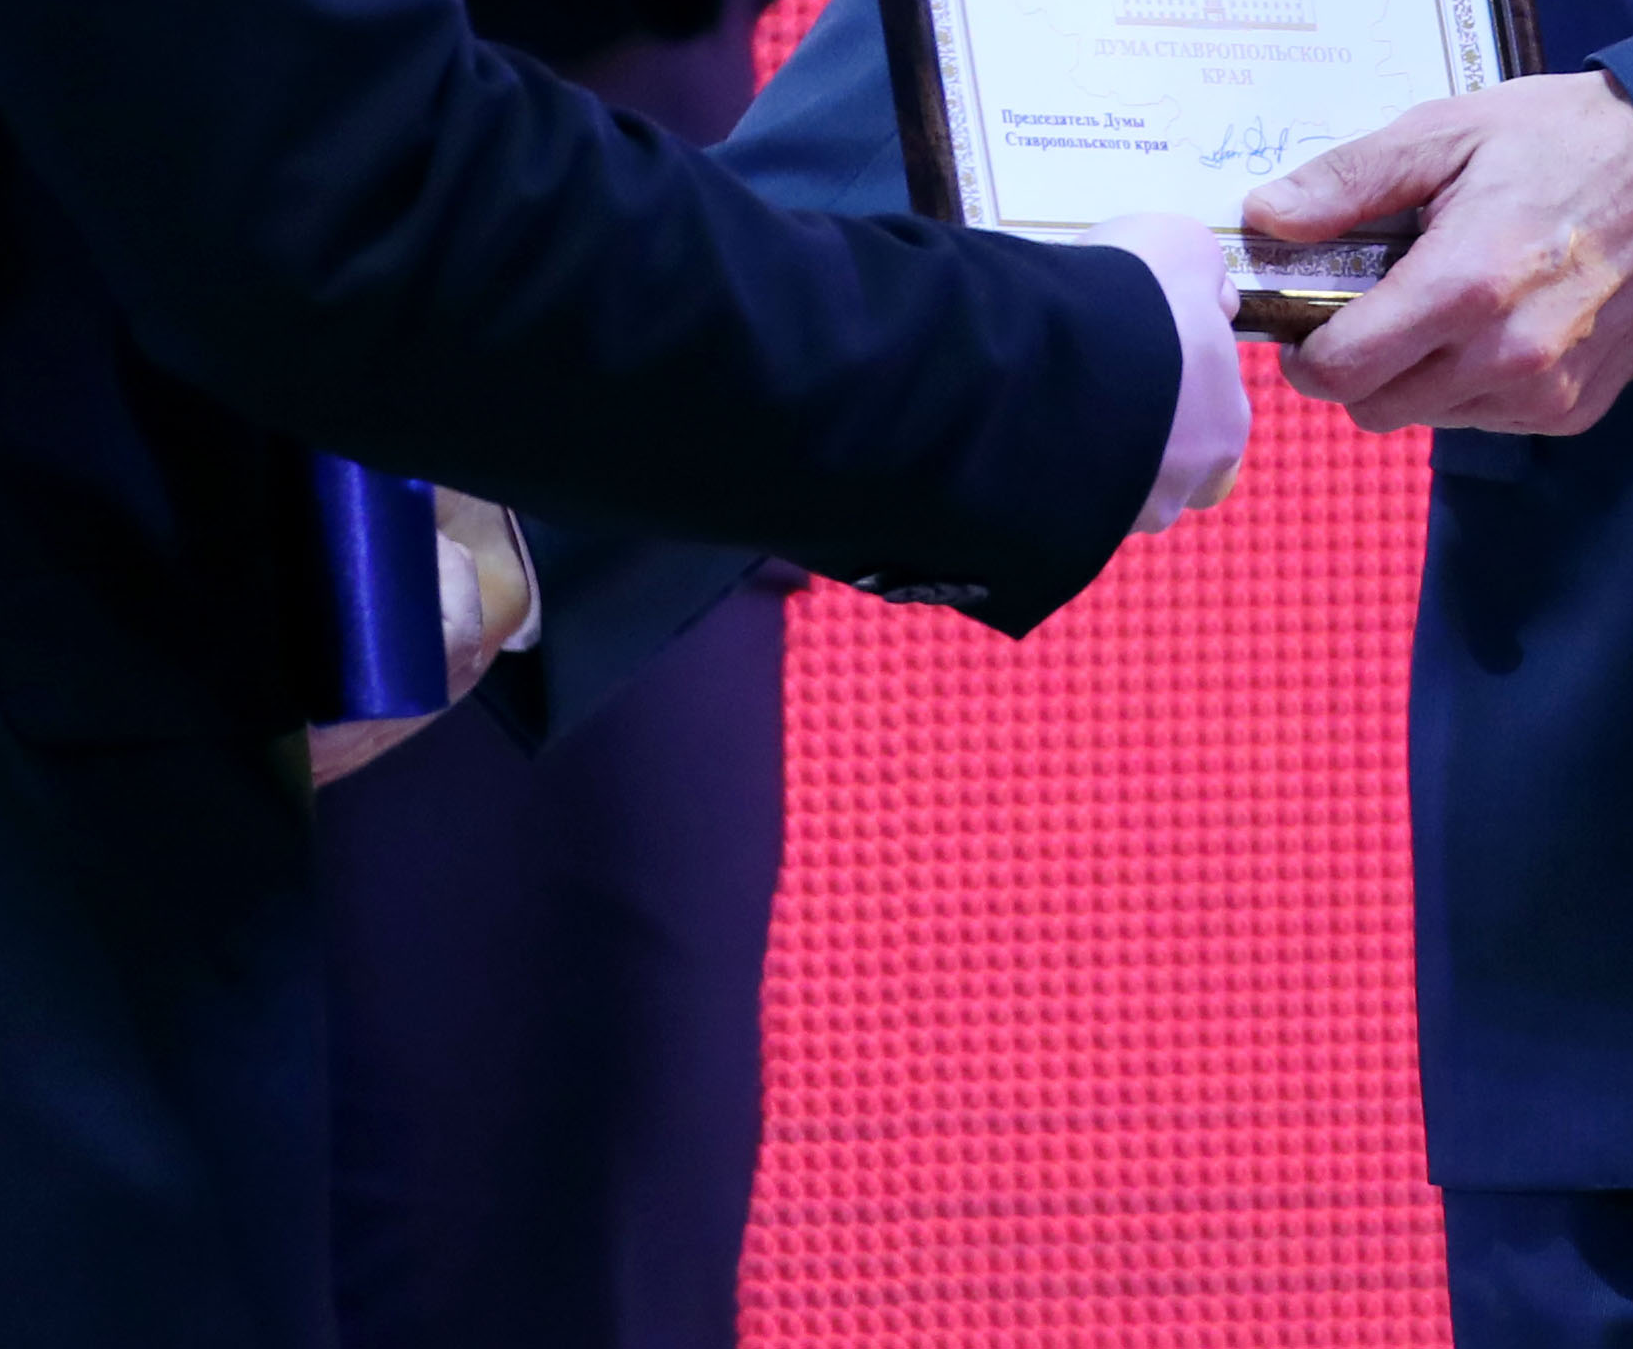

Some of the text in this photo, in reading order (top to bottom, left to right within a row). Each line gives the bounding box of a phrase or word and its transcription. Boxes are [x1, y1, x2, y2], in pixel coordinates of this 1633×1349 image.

[1094, 38, 1353, 64] ДУМА СТАВРОПОЛЬСКОГО
[1201, 67, 1254, 85] КРАЯ
[1001, 108, 1145, 130] Председатель Думы
[1005, 131, 1169, 154] Ставропольского края
